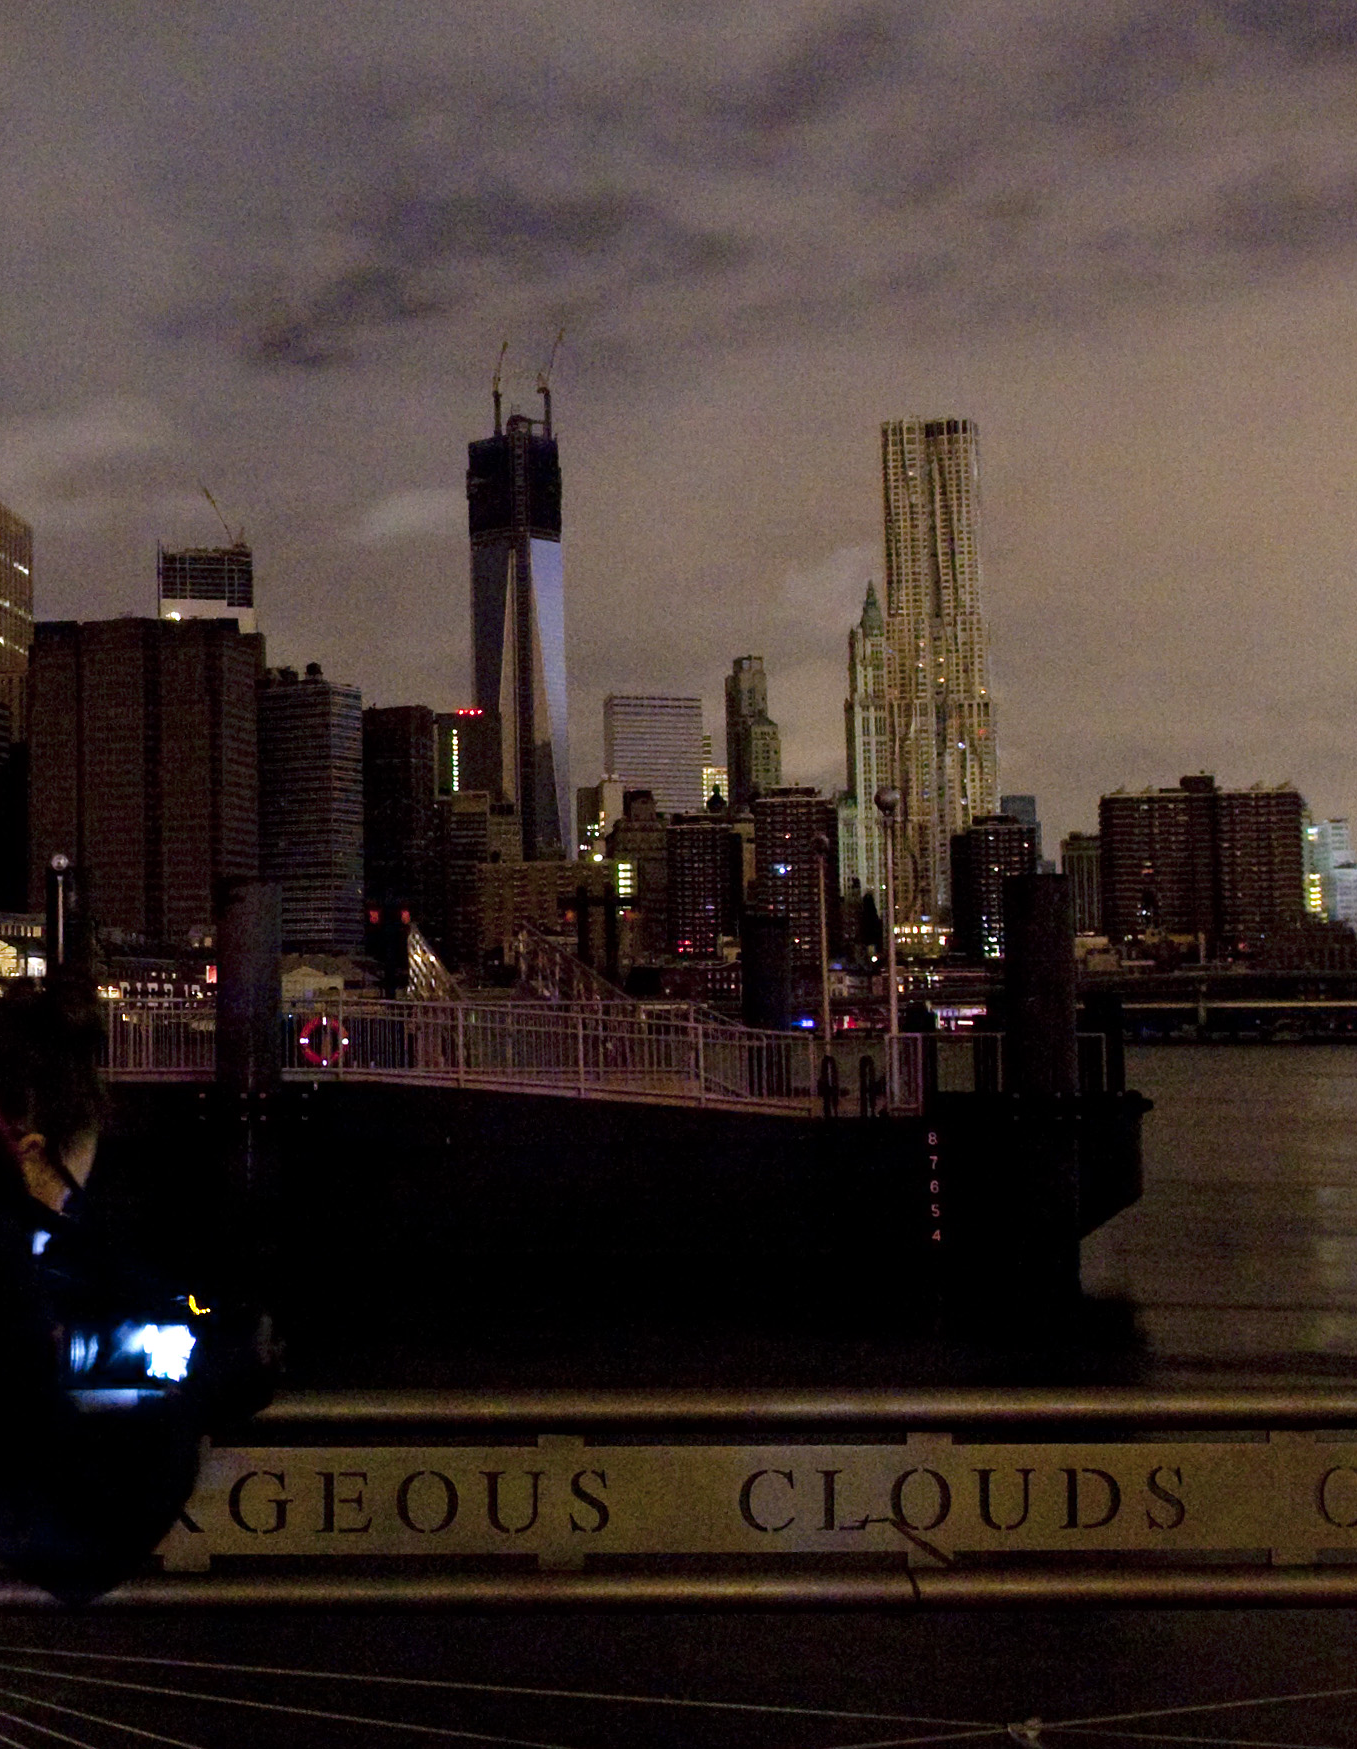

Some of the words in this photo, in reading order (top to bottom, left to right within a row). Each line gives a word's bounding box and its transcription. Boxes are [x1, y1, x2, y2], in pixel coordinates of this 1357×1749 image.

[927, 1131, 938, 1145] 8
[929, 1155, 939, 1170] 7
[929, 1180, 940, 1194] 6
[930, 1203, 941, 1218] 5
[931, 1229, 942, 1242] 4
[739, 1465, 1186, 1532] CLOUDS
